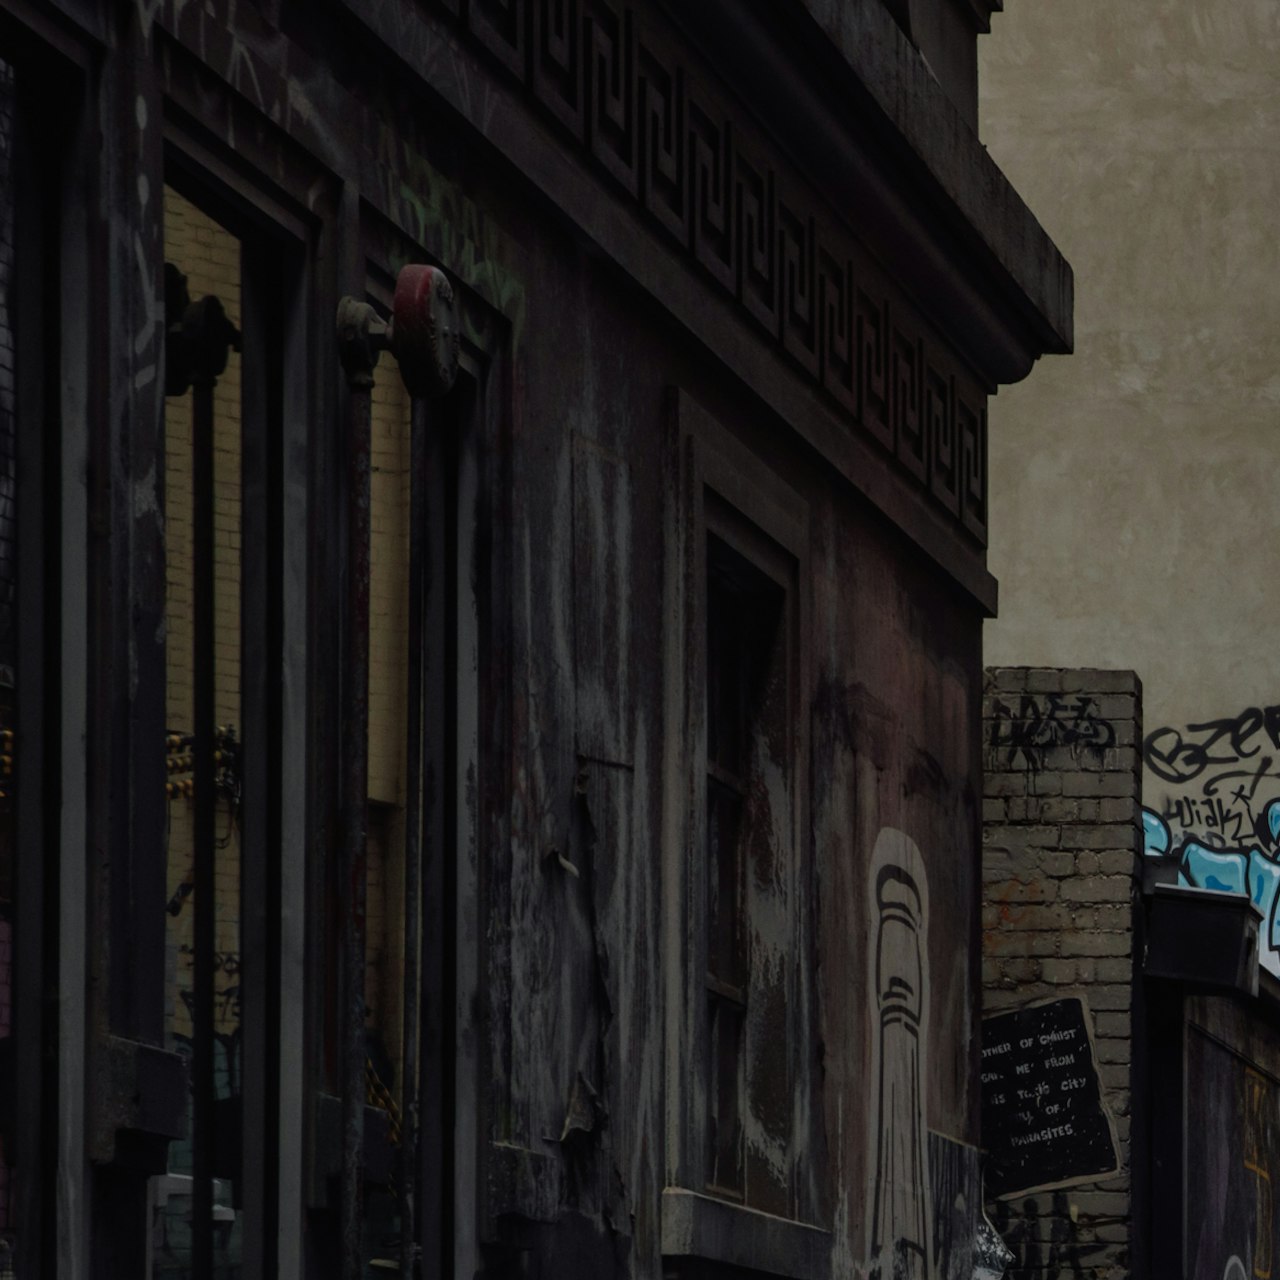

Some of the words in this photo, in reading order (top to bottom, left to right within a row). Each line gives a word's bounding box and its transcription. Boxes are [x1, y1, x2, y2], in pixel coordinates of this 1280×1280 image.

[1019, 1038, 1034, 1049] OF
[1015, 1063, 1031, 1075] ME
[1044, 1053, 1076, 1069] FROM
